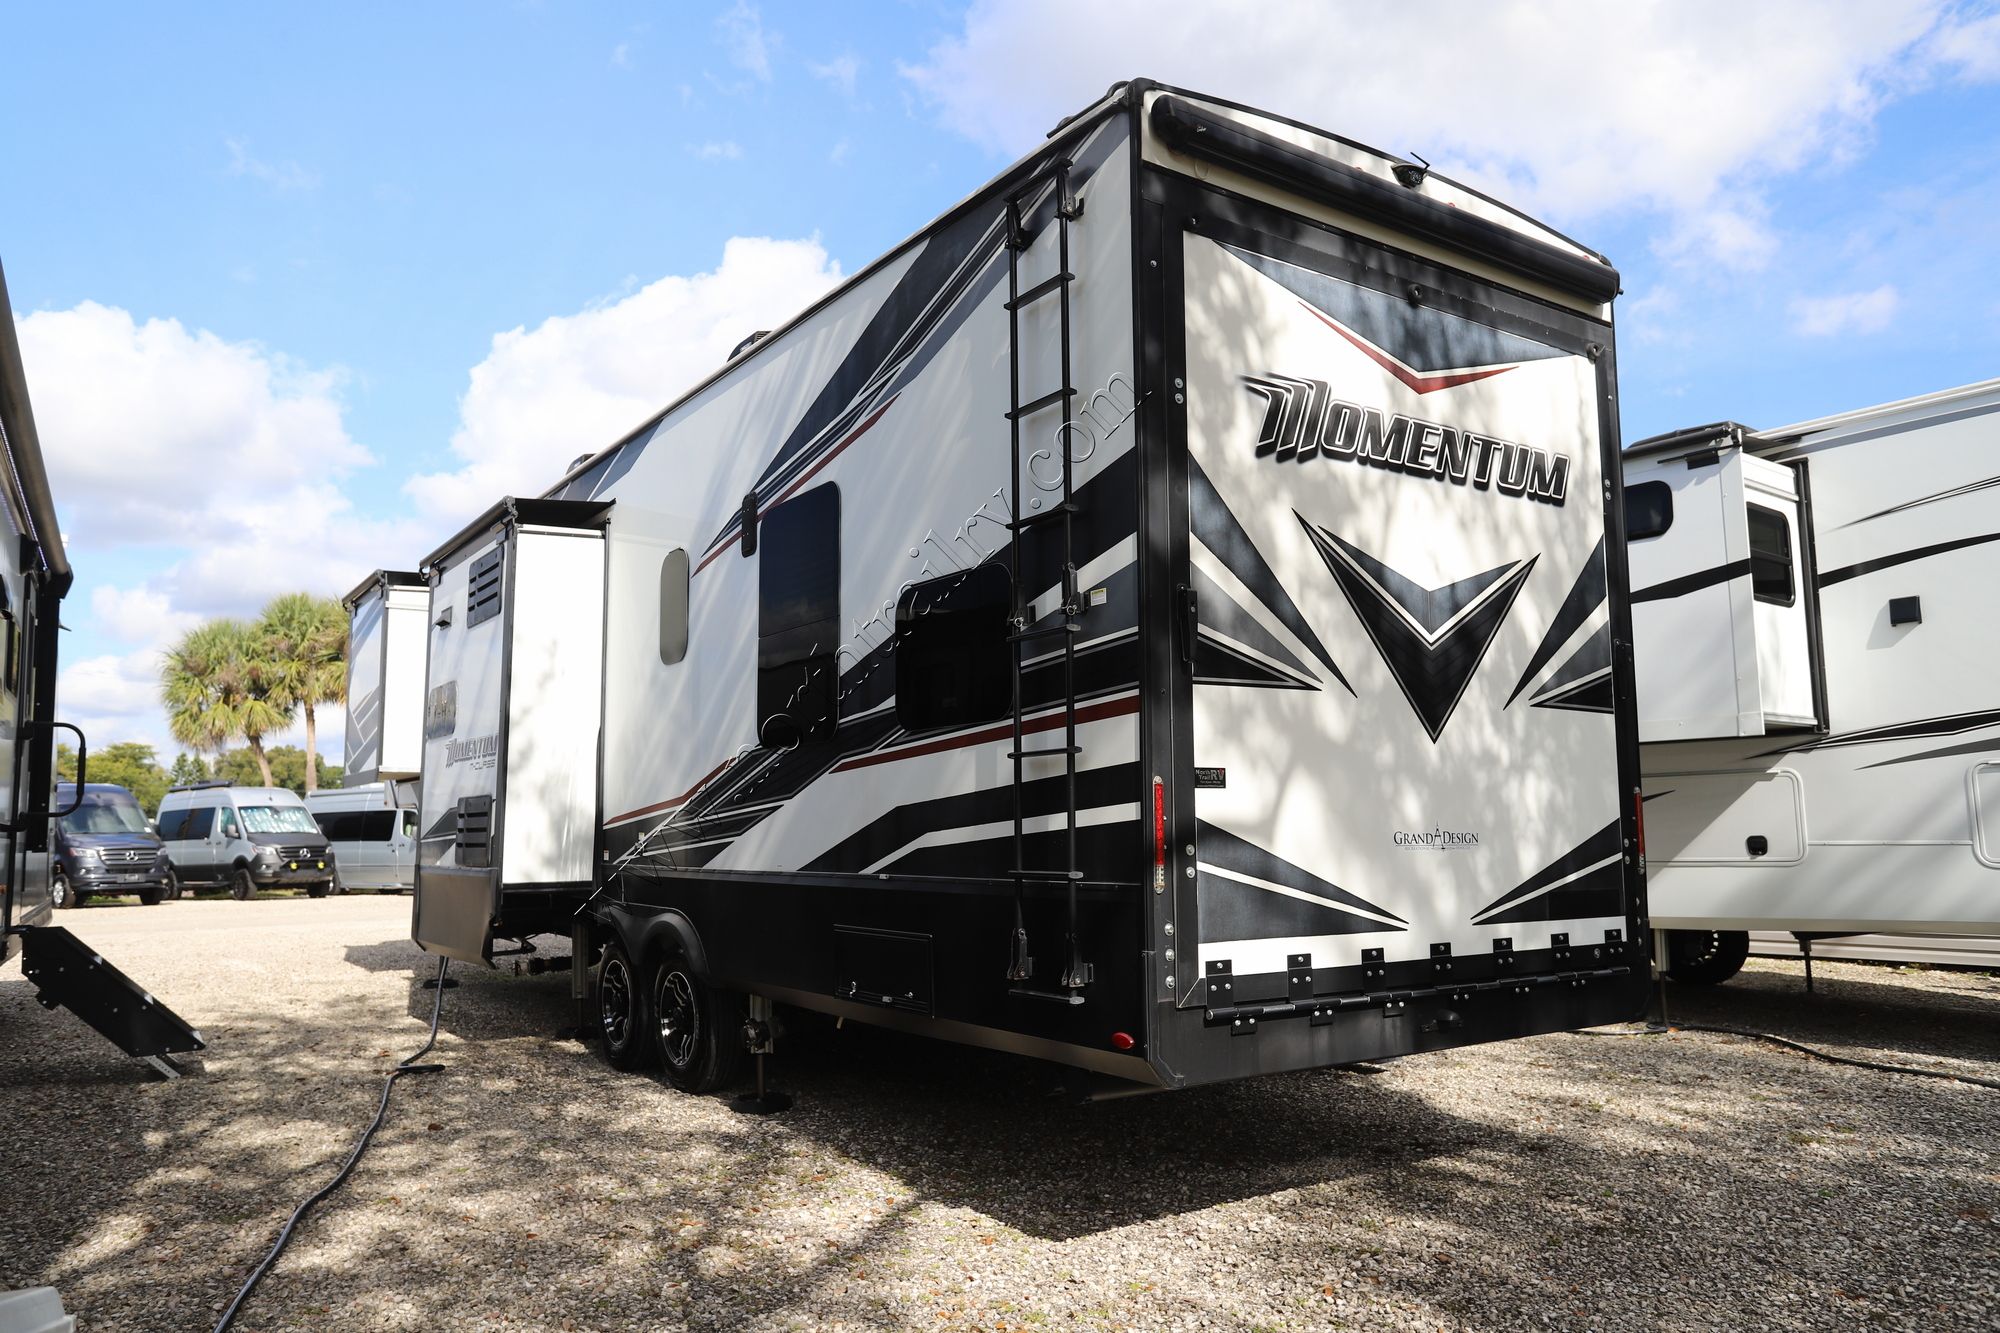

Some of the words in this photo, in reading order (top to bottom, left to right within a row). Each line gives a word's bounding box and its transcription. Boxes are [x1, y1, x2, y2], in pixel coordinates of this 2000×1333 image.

[1240, 373, 1571, 508] MOMENTUM
[446, 735, 498, 768] MOMENTUM
[1210, 769, 1224, 780] RV
[1393, 831, 1434, 845] GRAND
[1442, 831, 1479, 844] DESIGN
